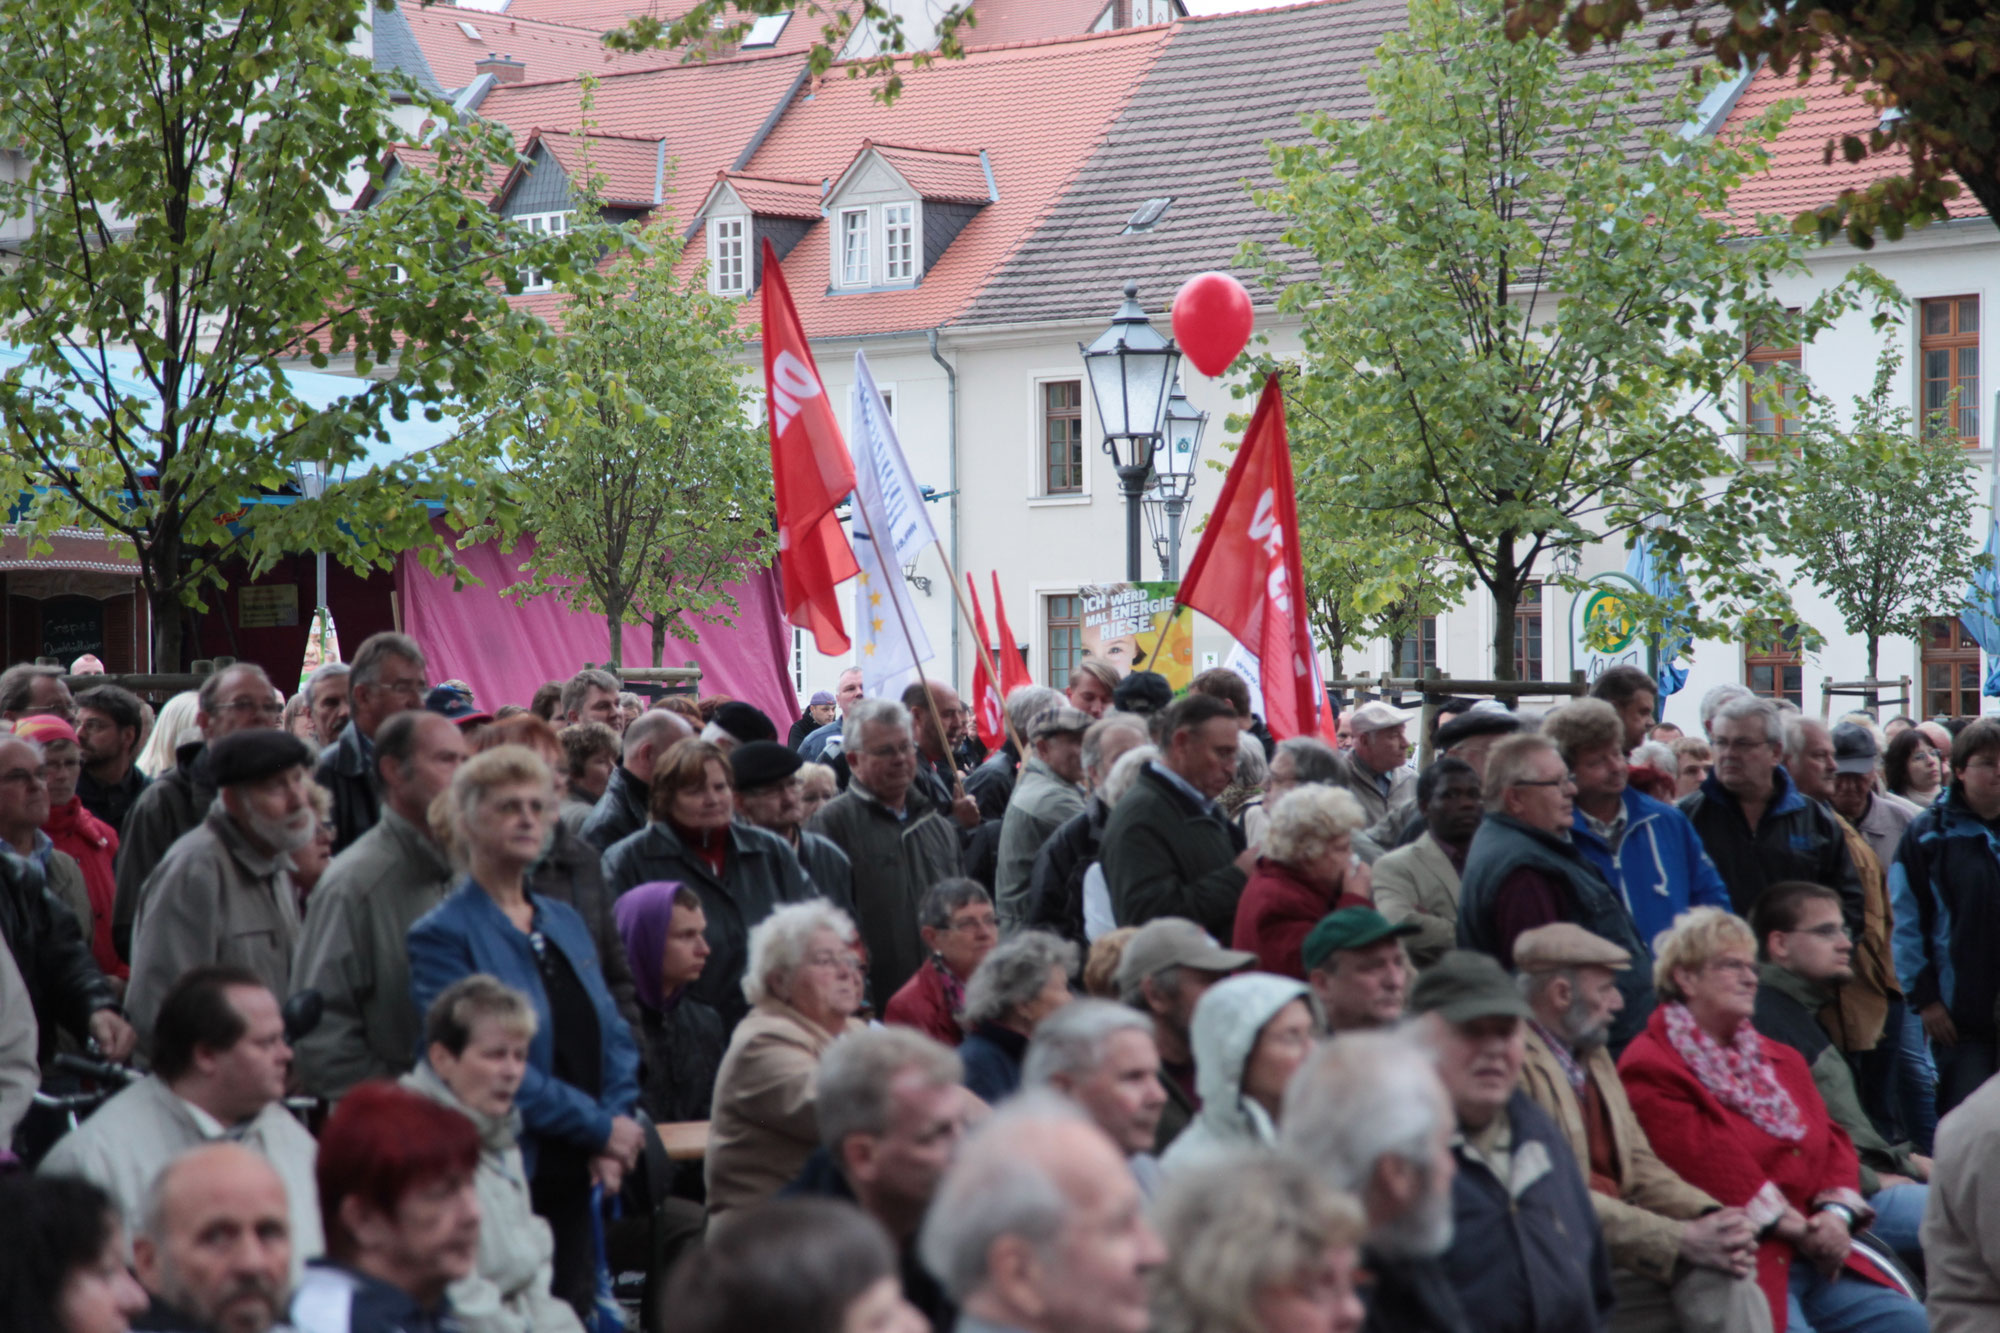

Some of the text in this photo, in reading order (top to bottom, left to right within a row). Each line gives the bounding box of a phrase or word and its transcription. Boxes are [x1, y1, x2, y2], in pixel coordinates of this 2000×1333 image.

[1083, 588, 1148, 613] ICH WERD
[1086, 596, 1175, 627] MAL ENERGIE
[1101, 615, 1156, 641] RIESE.
